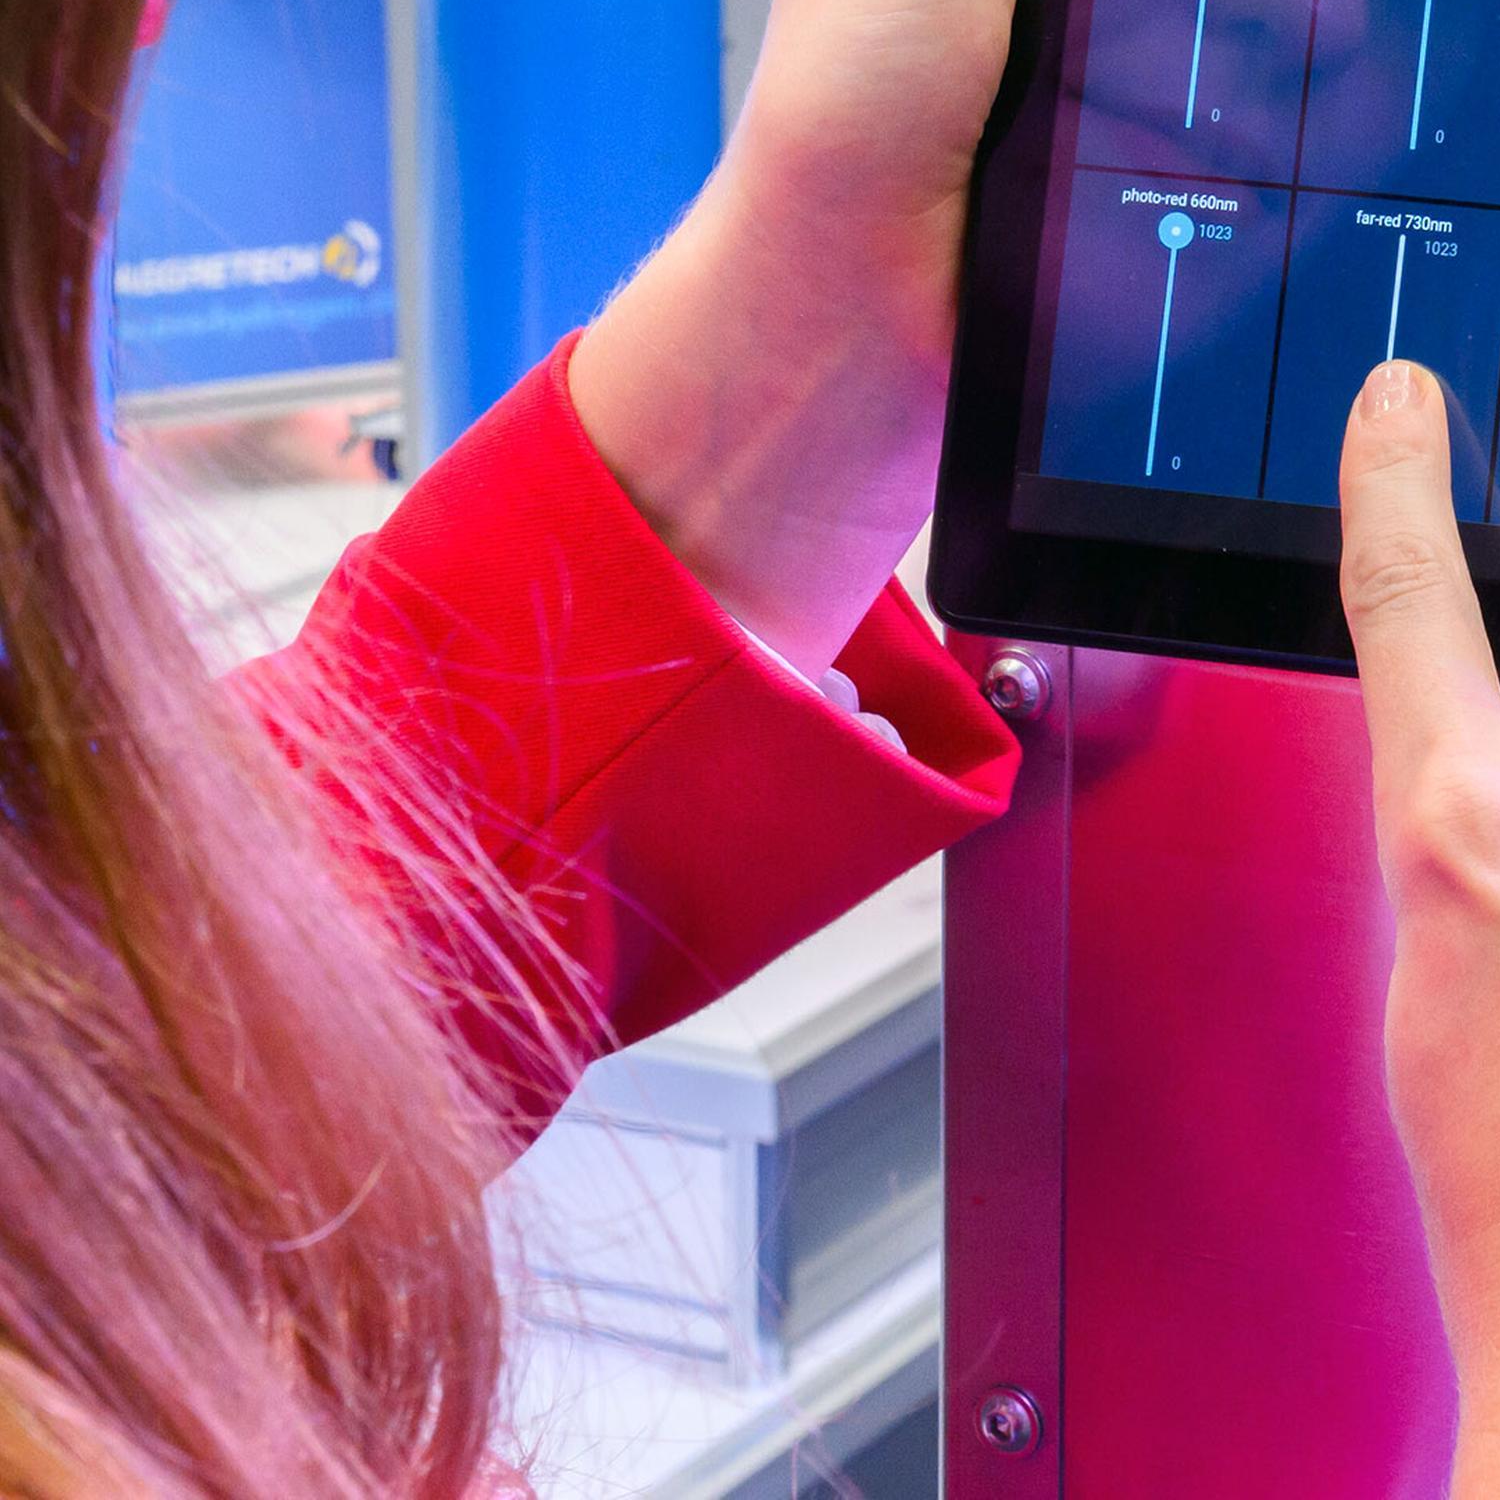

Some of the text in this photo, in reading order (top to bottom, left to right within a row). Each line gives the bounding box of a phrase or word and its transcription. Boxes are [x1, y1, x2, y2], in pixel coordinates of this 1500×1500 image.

[1211, 108, 1221, 123] 0
[1435, 129, 1445, 144] 0
[1121, 187, 1238, 212] photo-red 660nm
[1356, 209, 1453, 233] far-red 730nm
[1199, 223, 1233, 241] 1023
[1425, 240, 1458, 257] 1023
[1171, 455, 1181, 471] 0
